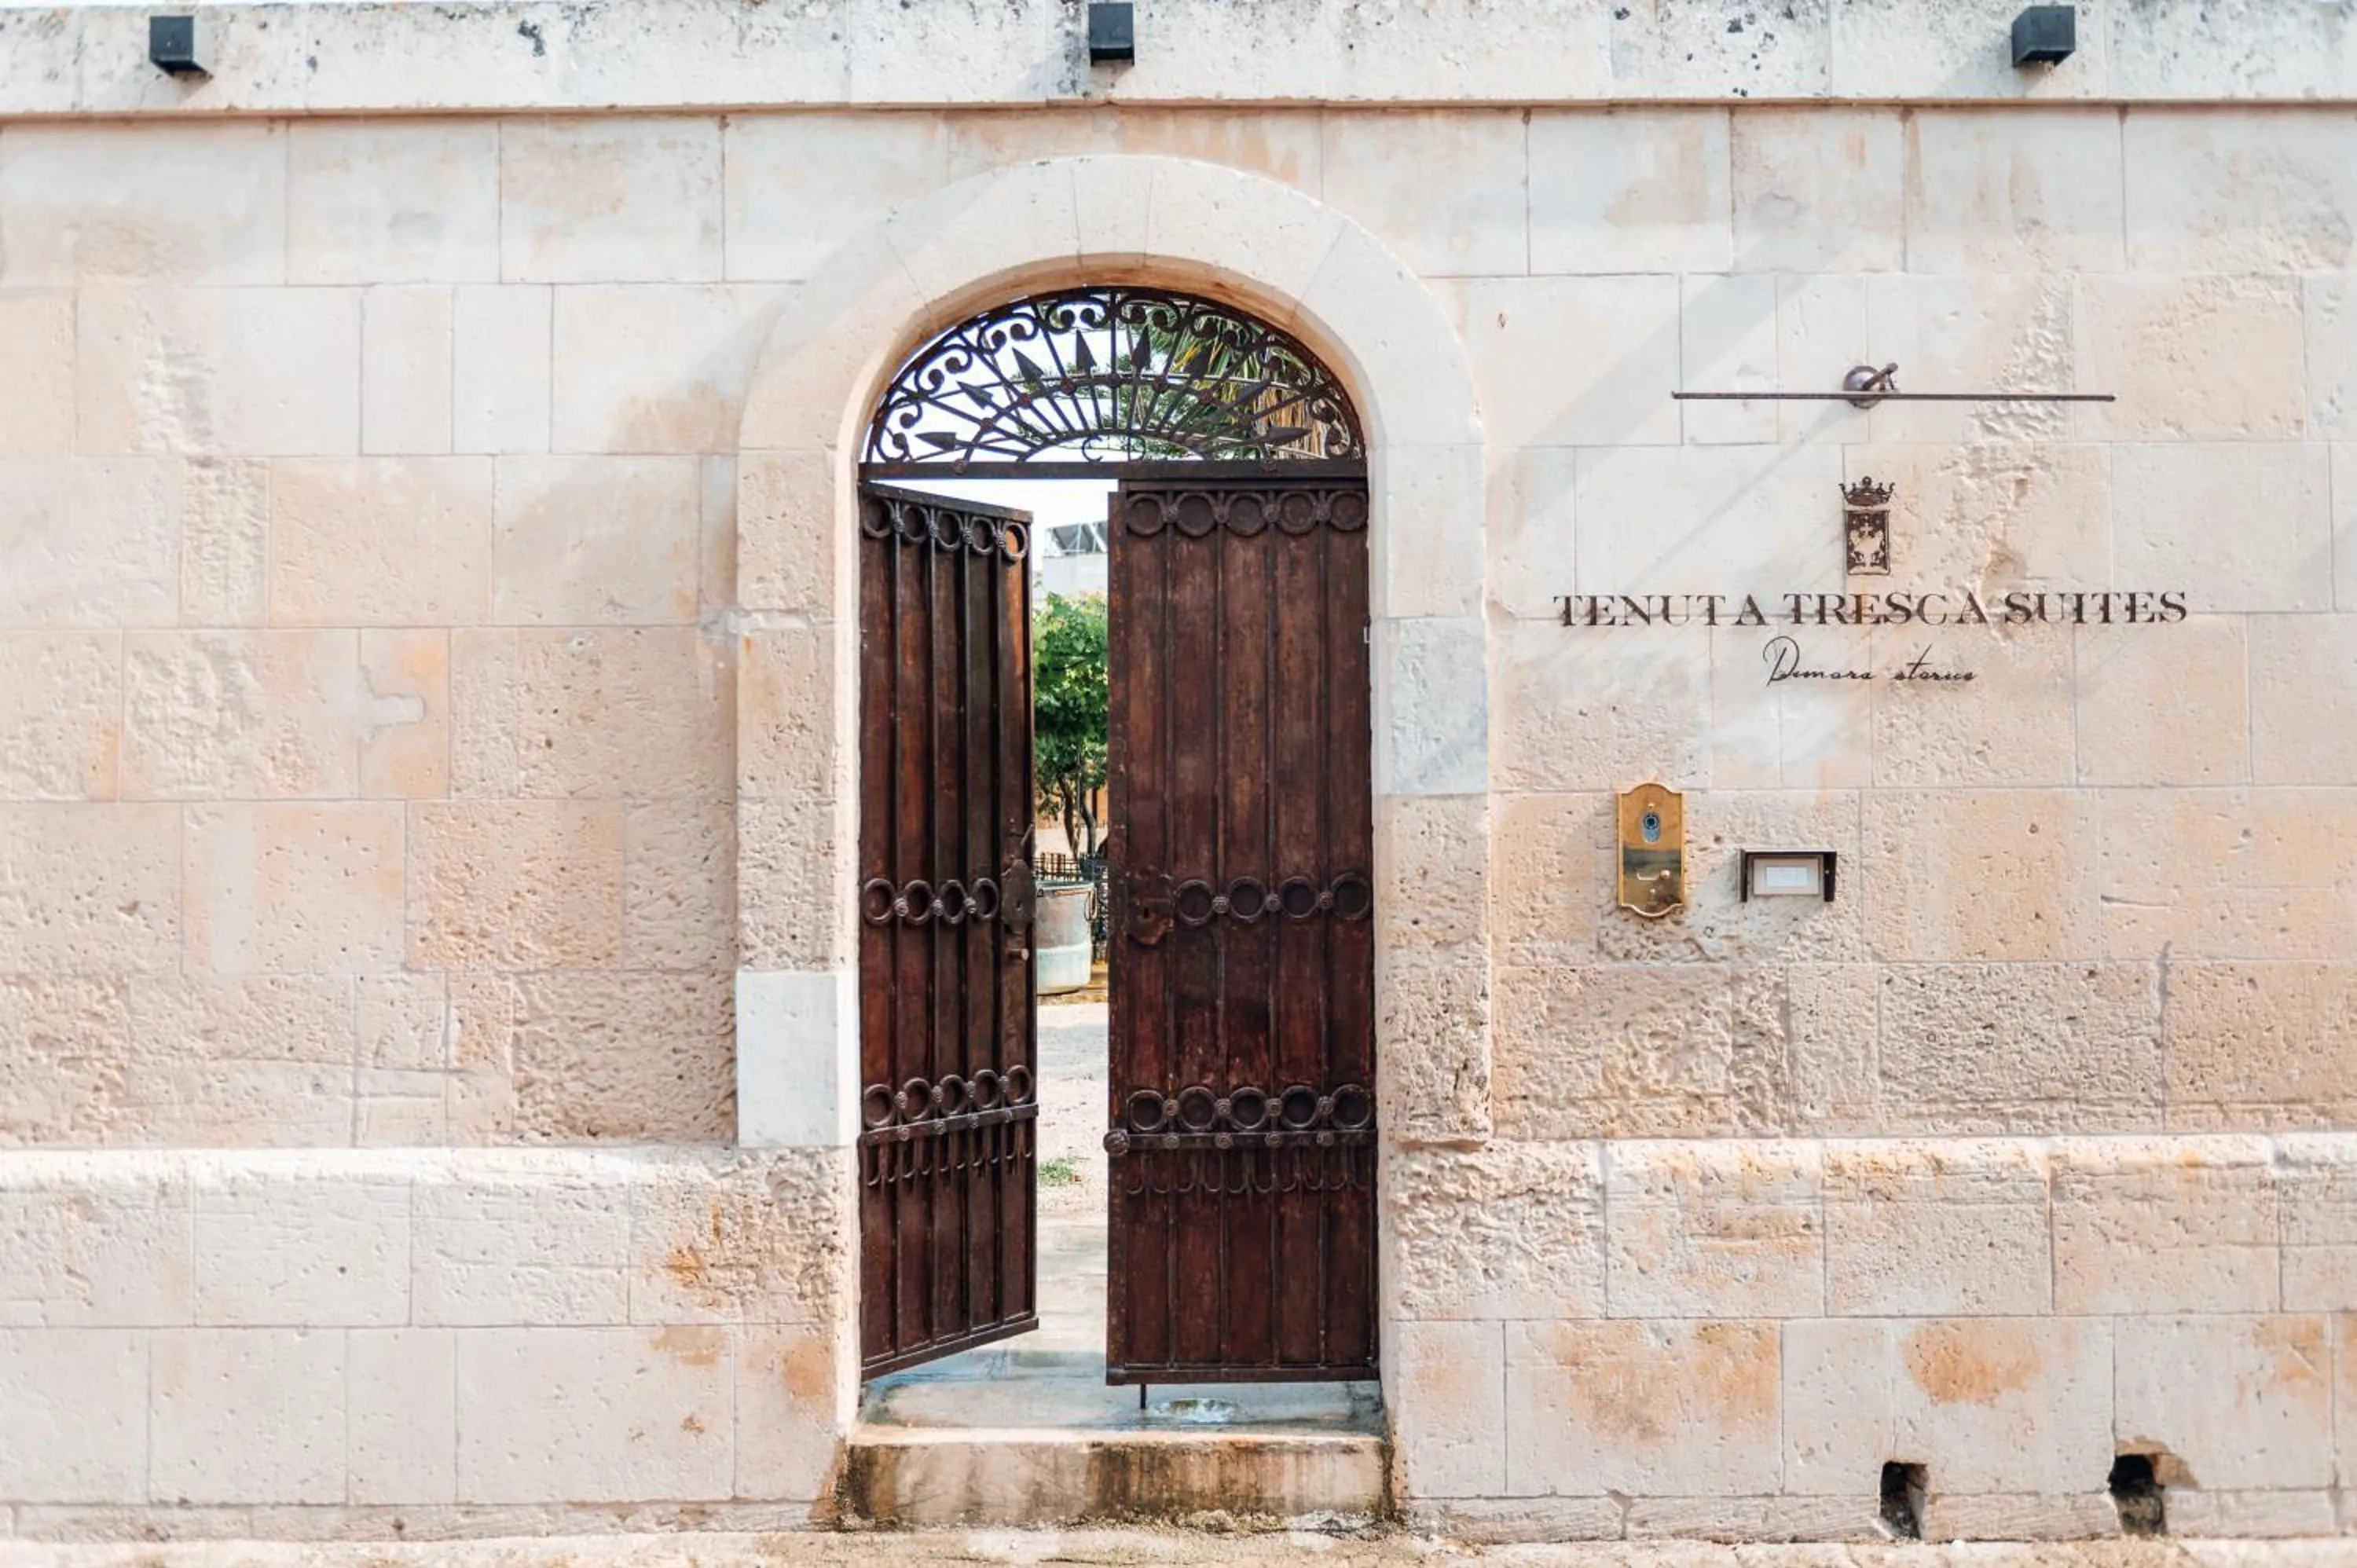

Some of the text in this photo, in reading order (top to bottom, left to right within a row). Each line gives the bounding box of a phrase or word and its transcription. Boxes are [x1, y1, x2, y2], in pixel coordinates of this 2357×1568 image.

[1553, 591, 2187, 626] TENUTA TRESCA SUITES
